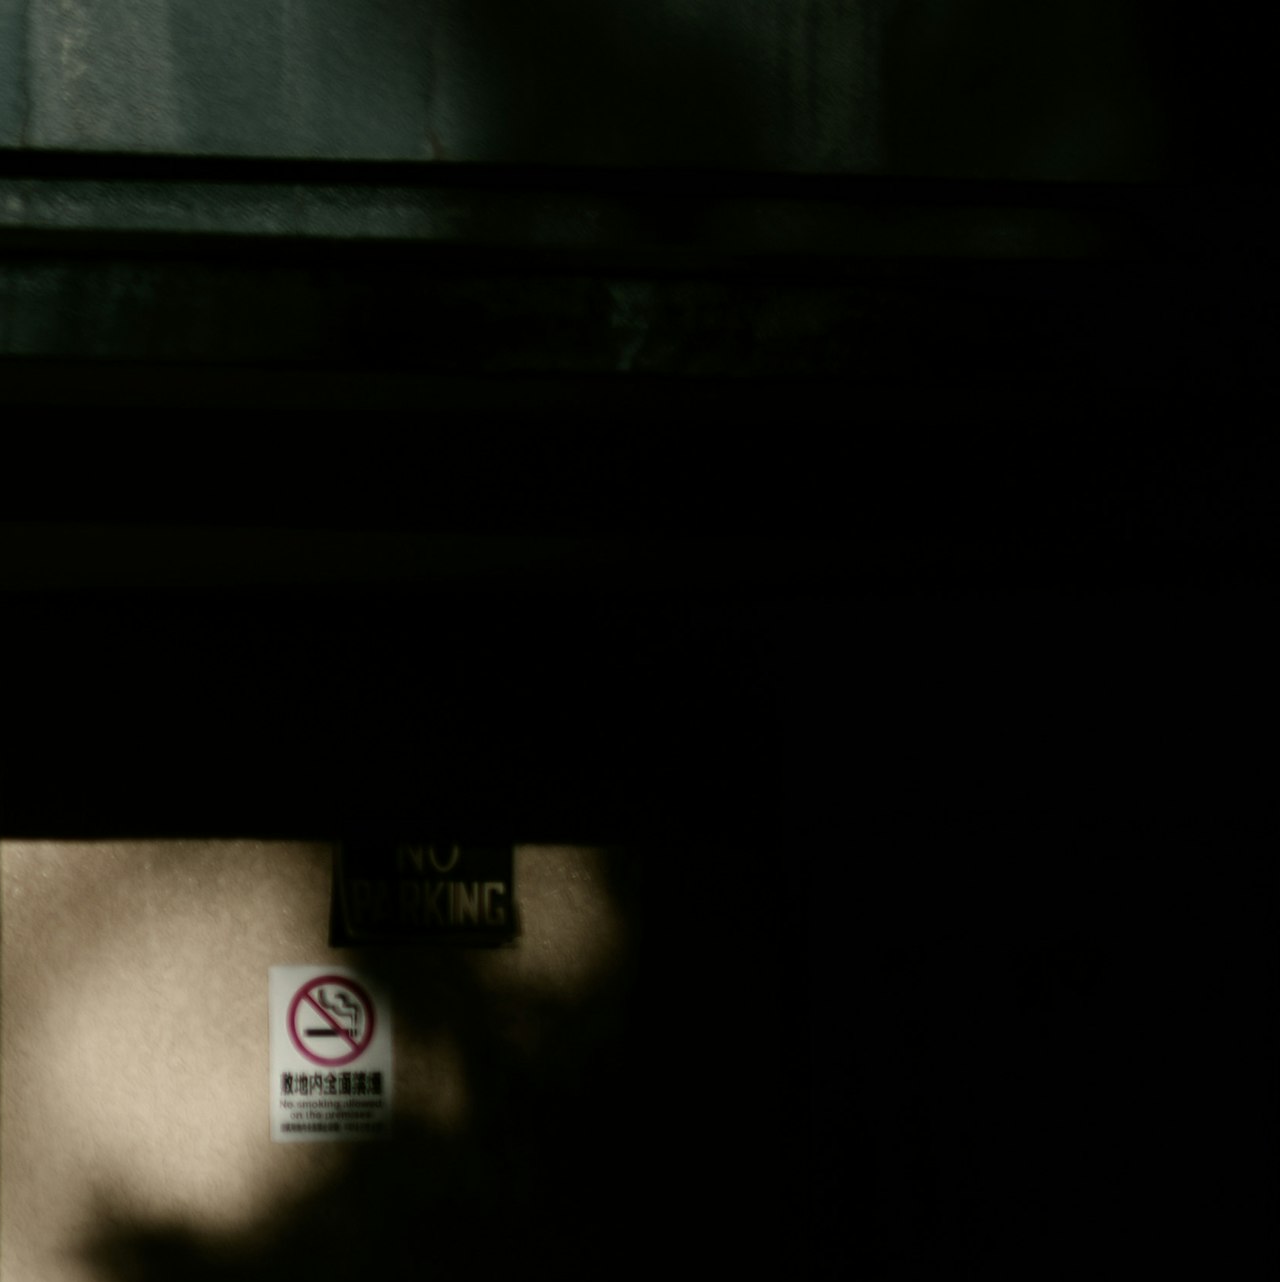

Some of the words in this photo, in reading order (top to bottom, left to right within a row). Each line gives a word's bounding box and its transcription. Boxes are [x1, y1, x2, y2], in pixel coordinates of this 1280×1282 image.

[398, 837, 462, 874] NO
[352, 881, 506, 926] PARKING
[281, 1072, 381, 1095] 敷地内全面禁煙
[280, 1100, 295, 1109] No
[297, 1100, 341, 1110] smoking
[343, 1100, 383, 1109] allowed
[306, 1111, 322, 1119] the
[325, 1111, 372, 1121] premises
